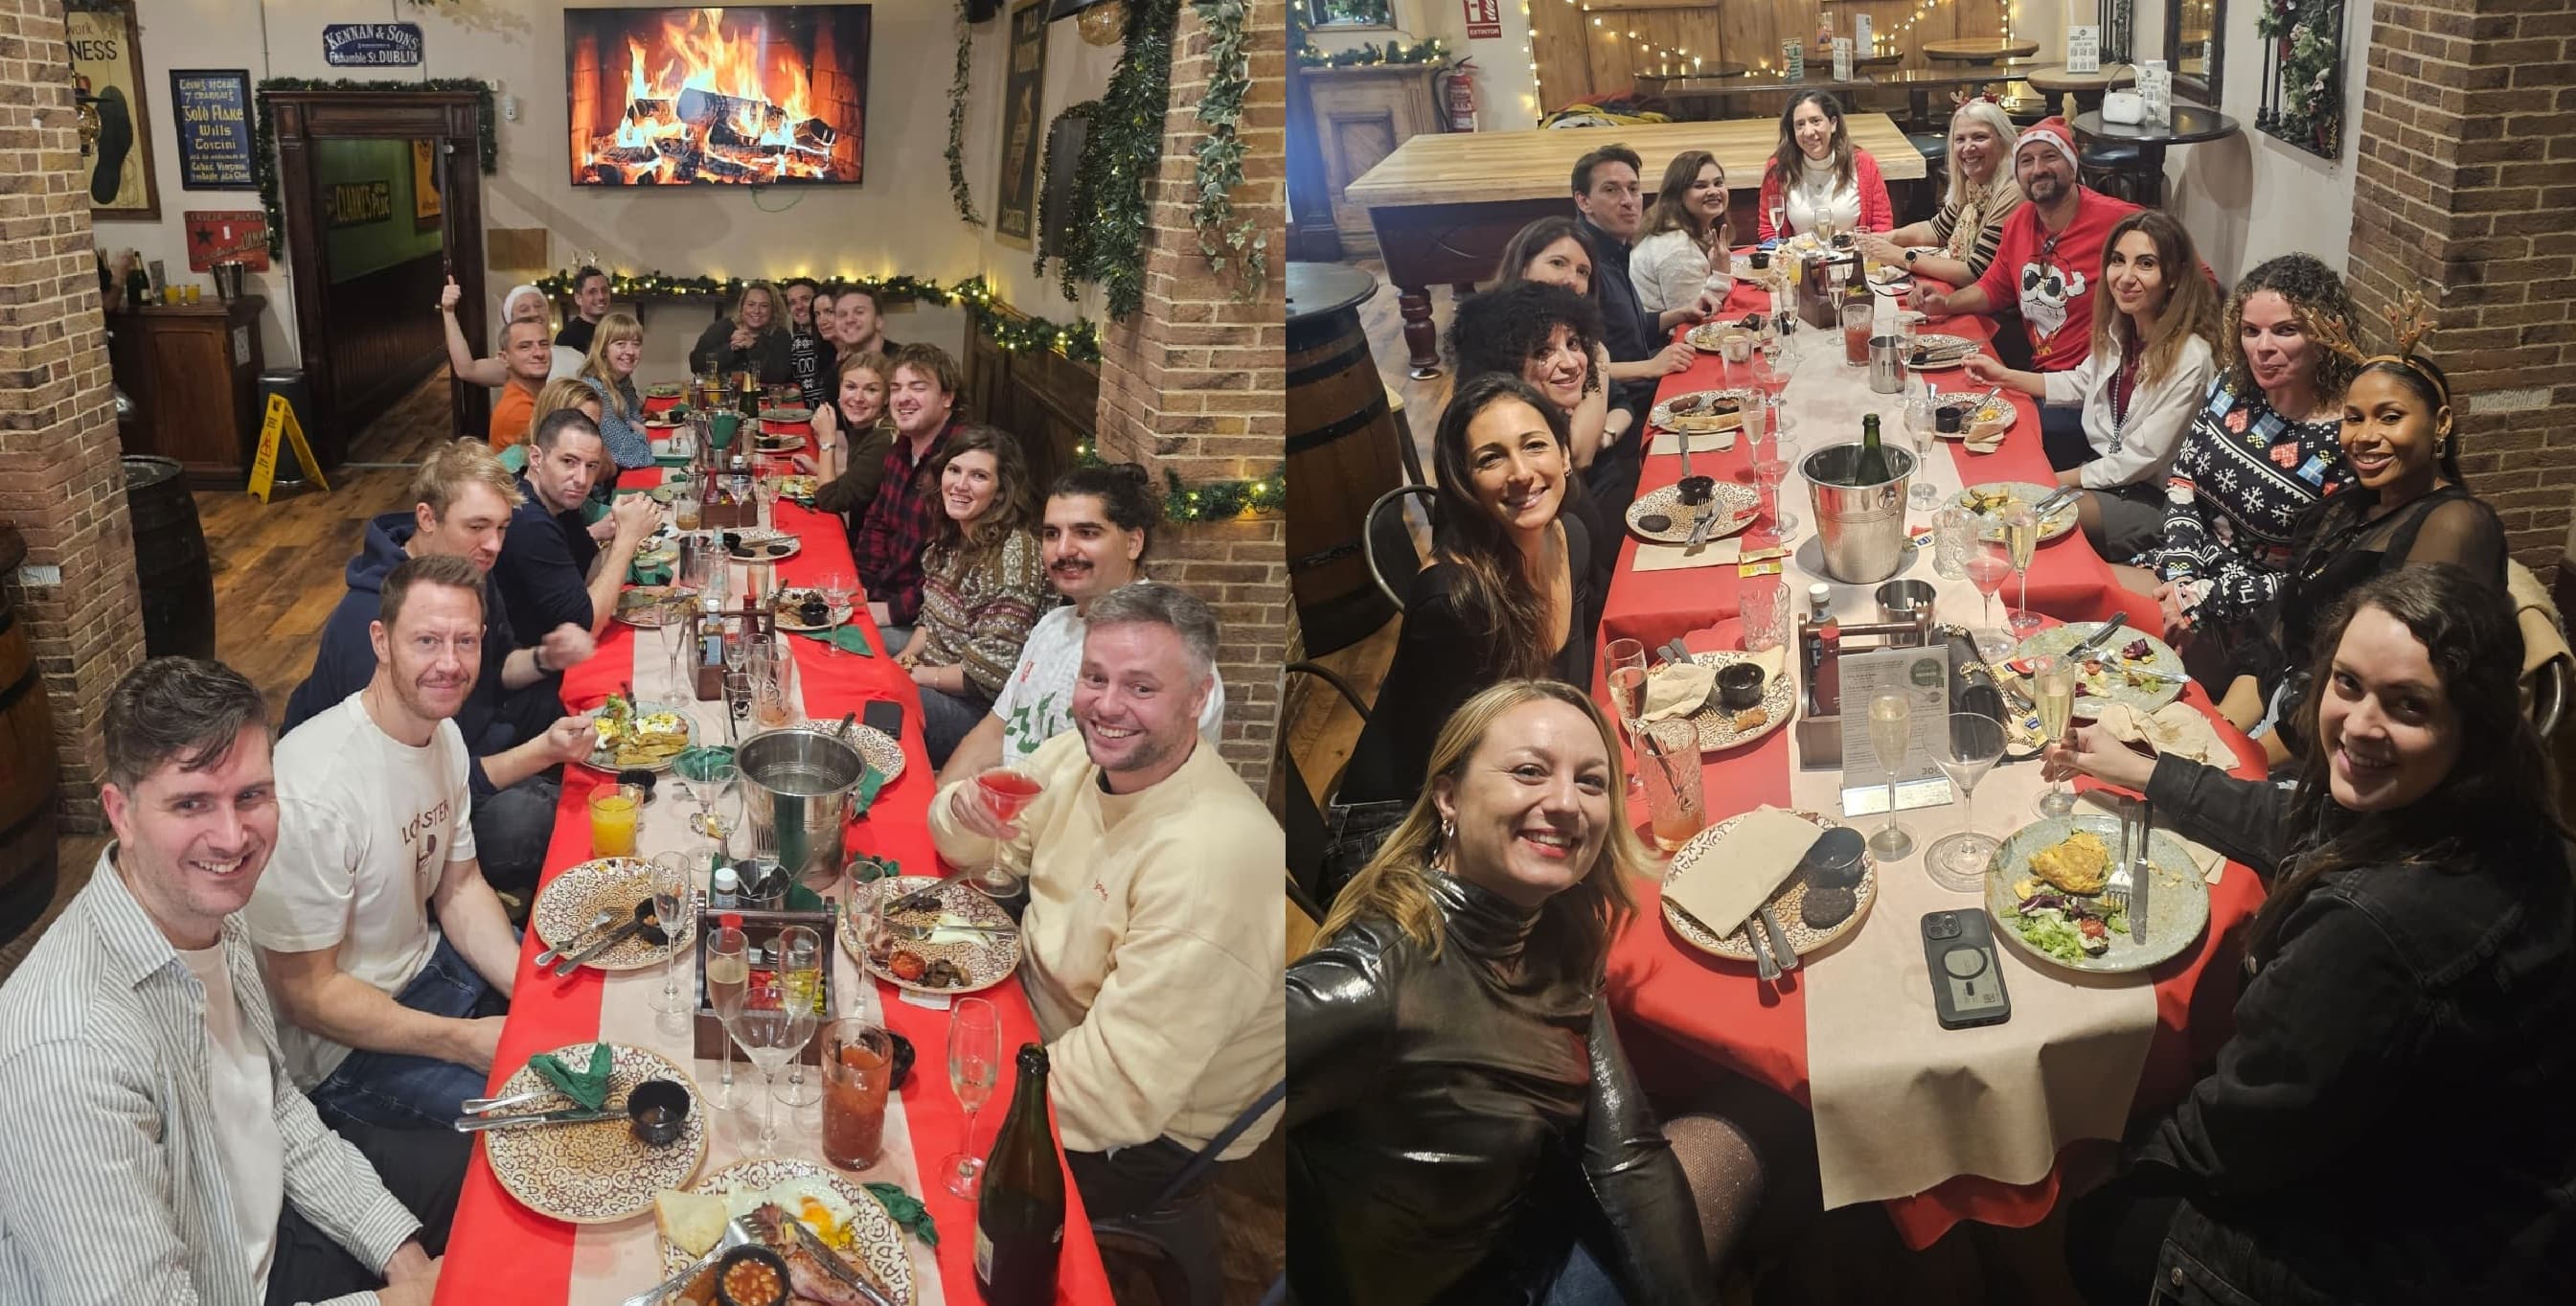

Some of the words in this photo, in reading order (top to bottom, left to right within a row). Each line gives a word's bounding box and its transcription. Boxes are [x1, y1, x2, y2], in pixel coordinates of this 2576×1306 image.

[326, 24, 375, 49] KENNAN
[376, 25, 384, 39] &
[378, 49, 419, 63] DUBLIN
